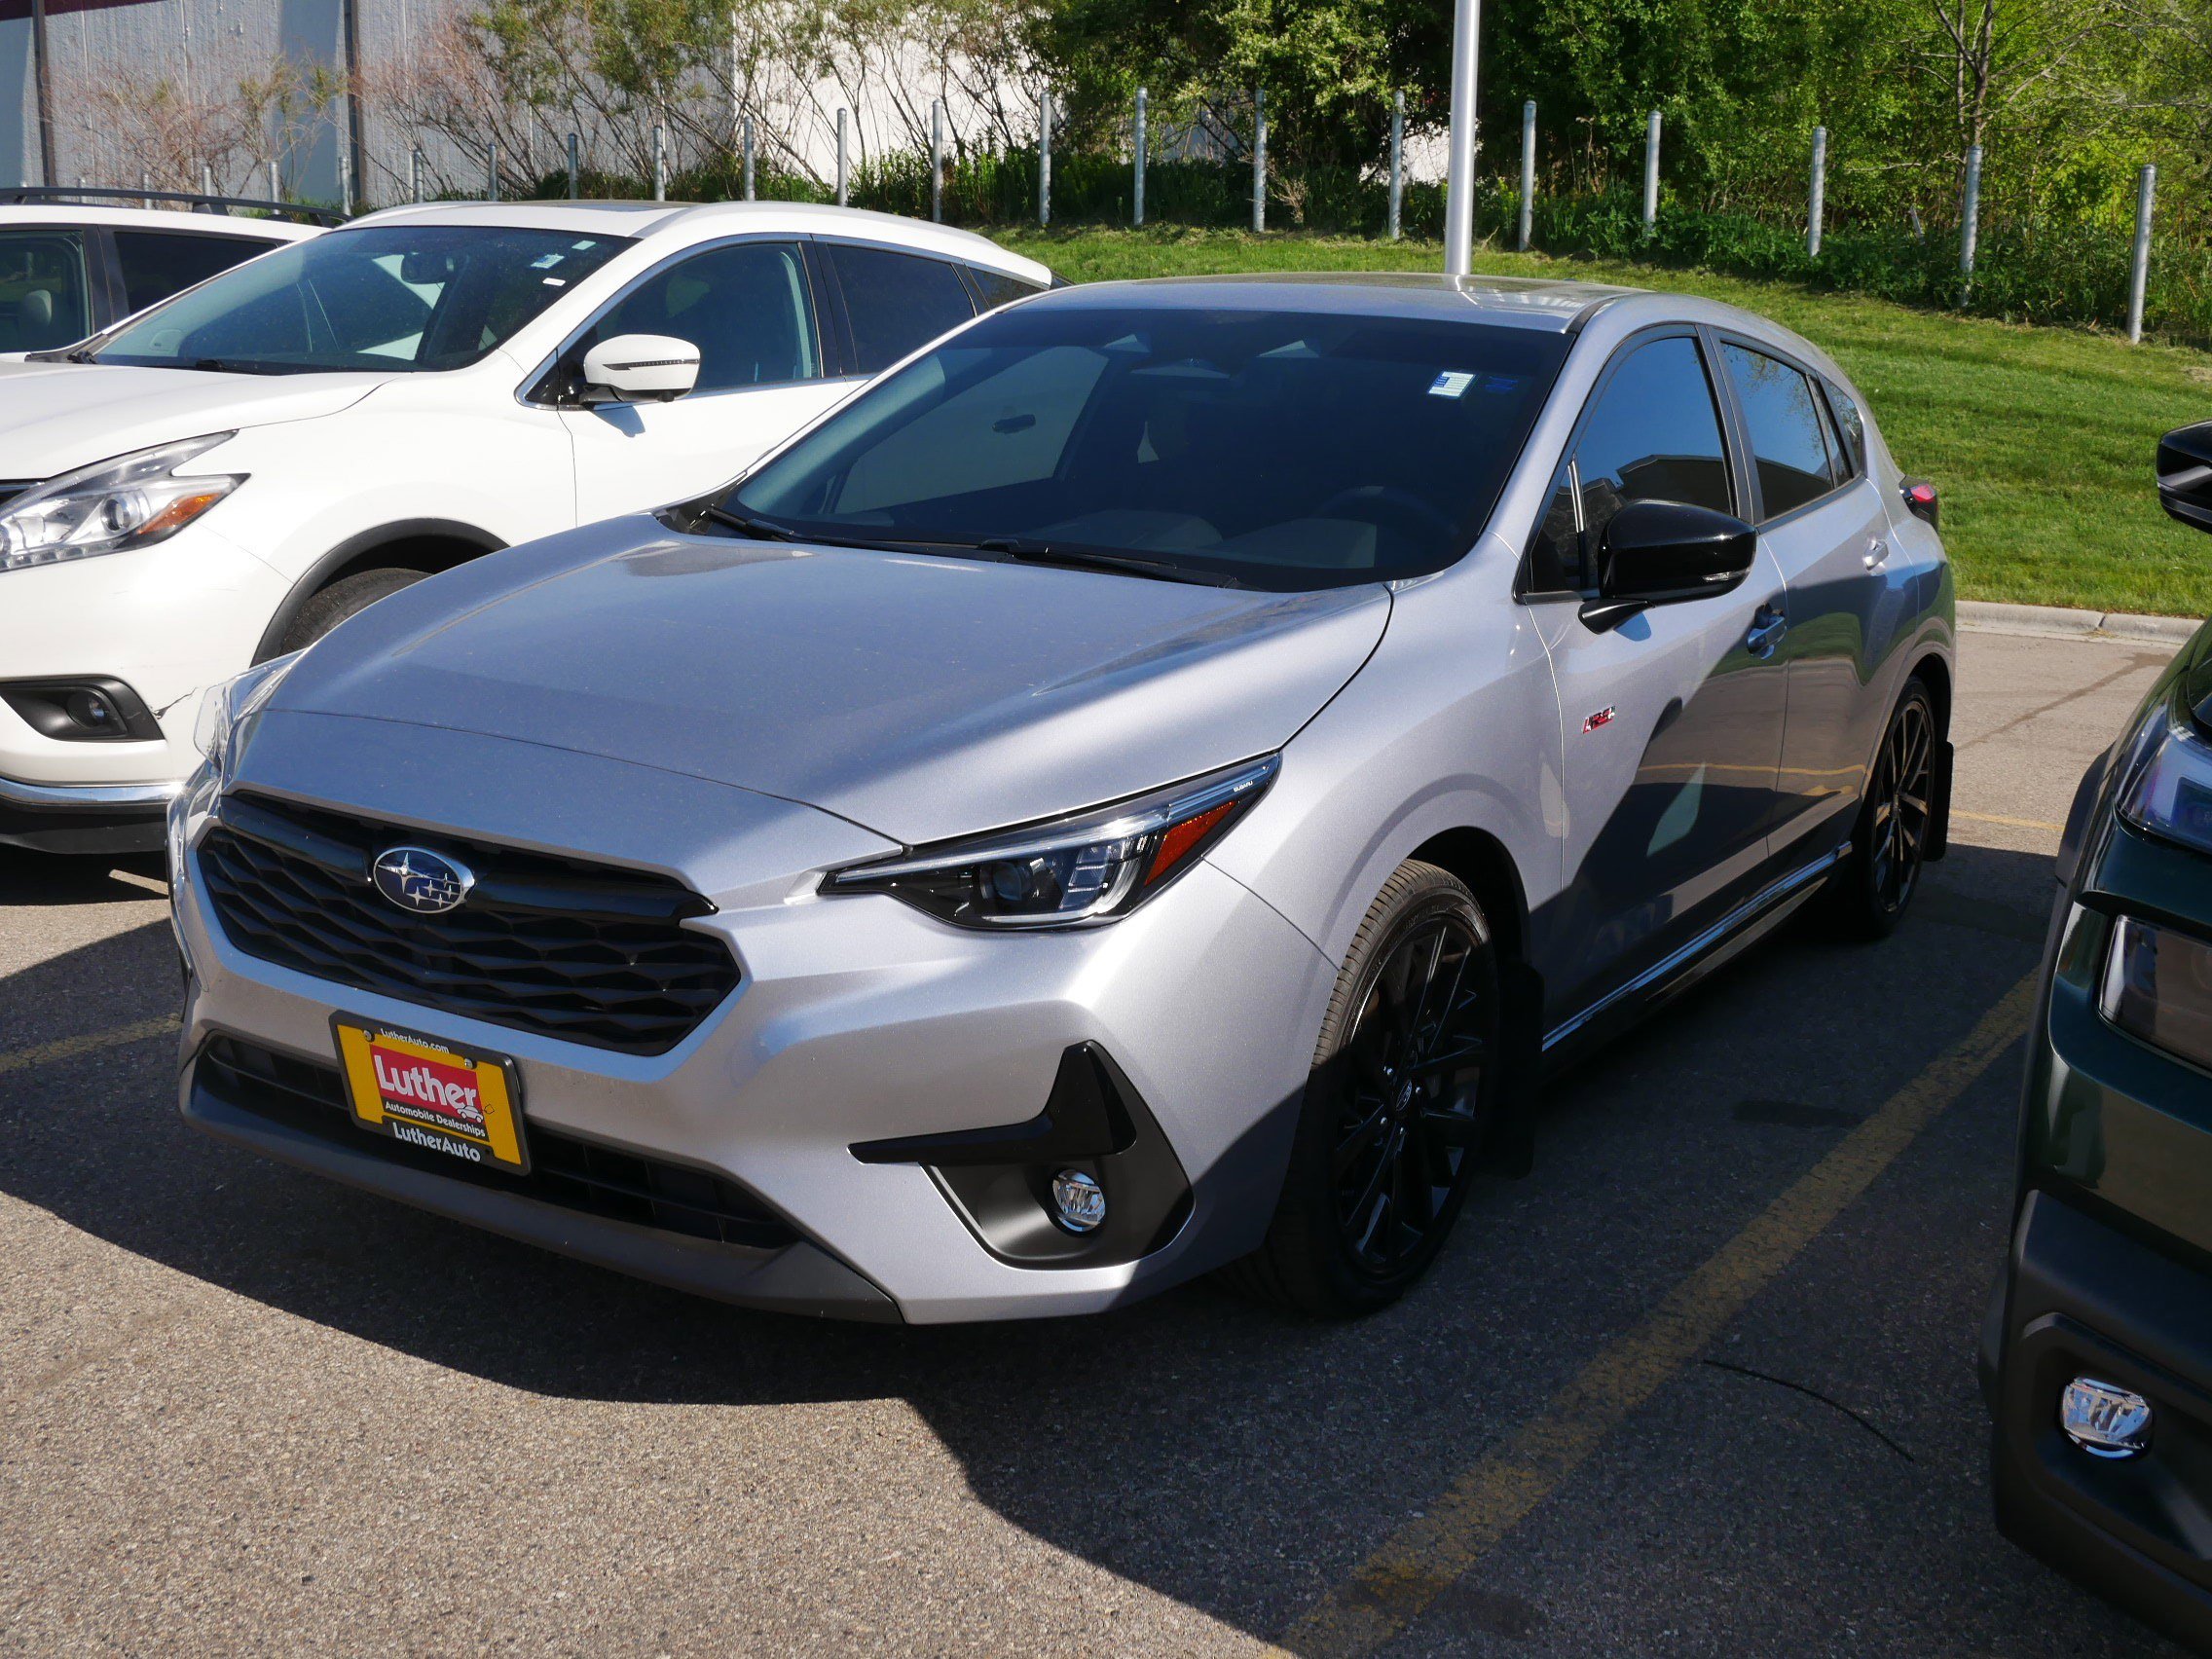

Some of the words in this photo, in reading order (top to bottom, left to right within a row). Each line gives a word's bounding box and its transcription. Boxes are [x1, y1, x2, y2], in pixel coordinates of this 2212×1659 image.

[380, 1028, 450, 1053] LutherAuto.com
[374, 1054, 476, 1109] Luther
[386, 1101, 435, 1122] Automobile
[436, 1114, 486, 1137] Dealerships
[392, 1122, 481, 1161] LutherAuto
